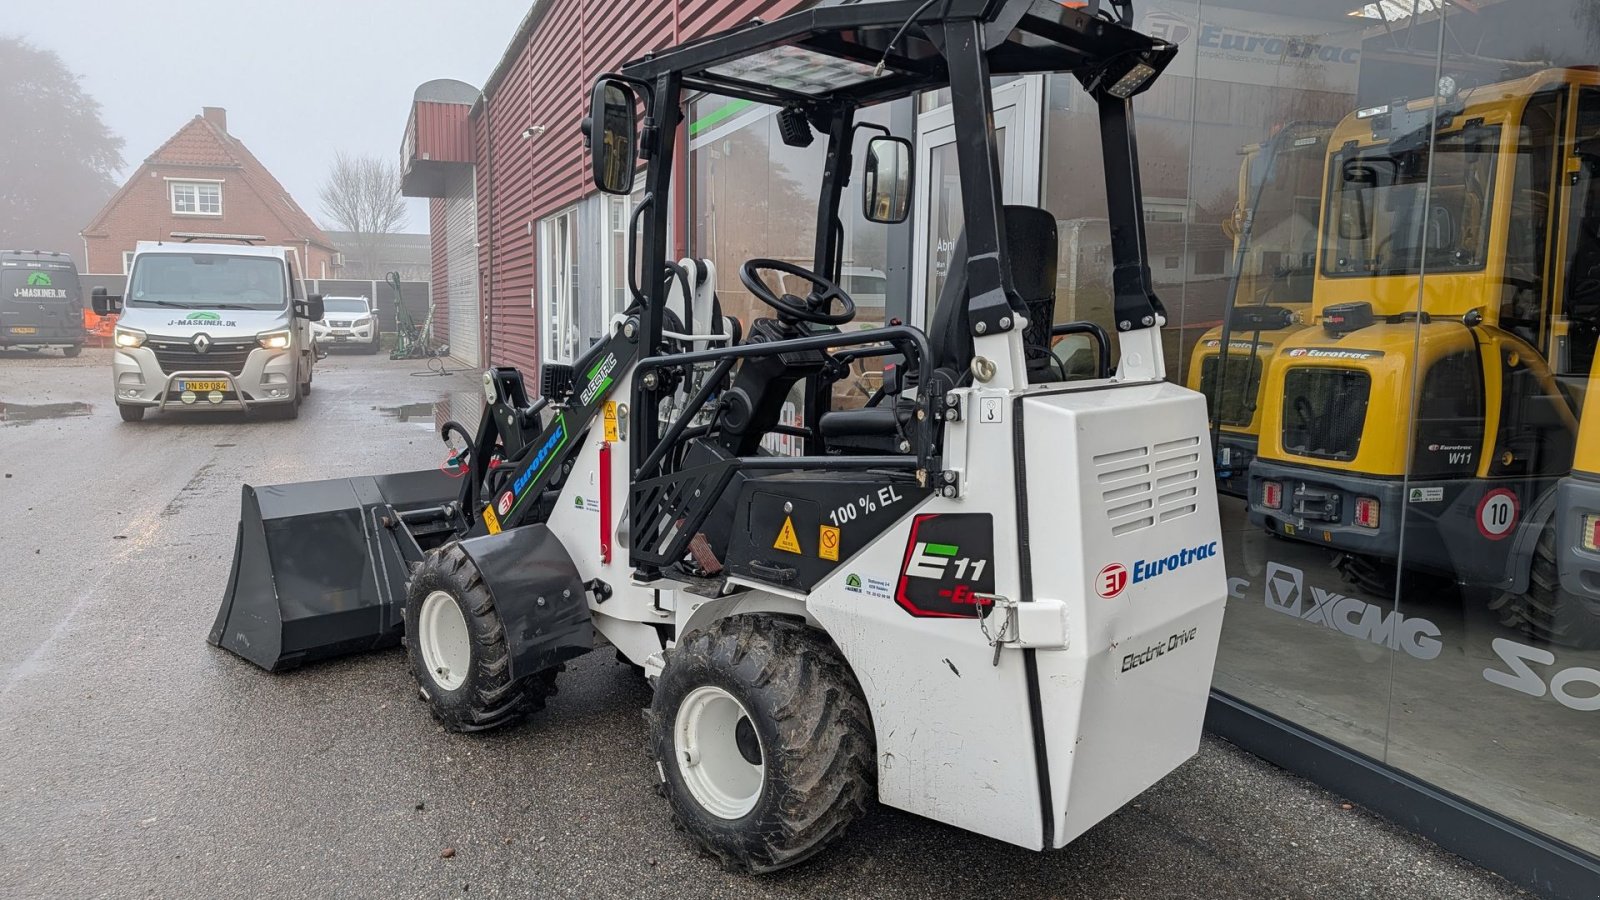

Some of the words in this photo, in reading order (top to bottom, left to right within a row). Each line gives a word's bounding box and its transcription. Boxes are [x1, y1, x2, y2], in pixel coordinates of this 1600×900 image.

[1200, 23, 1361, 64] Eurotrac
[13, 288, 67, 299] J-MASKINER.DK
[167, 319, 237, 328] J-MASKINER.DK
[1308, 349, 1371, 360] Eurotrac
[185, 382, 197, 390] DN
[198, 382, 209, 390] 89
[210, 382, 227, 390] 084
[579, 352, 617, 407] ELECTRIC
[513, 424, 563, 496] Eurotrac
[1448, 452, 1472, 465] W11
[829, 501, 857, 527] 100
[858, 494, 876, 515] %
[877, 485, 903, 507] EL
[1491, 503, 1508, 526] 10
[1132, 540, 1217, 585] Eurotrac
[1301, 585, 1443, 660] XCMG
[1120, 640, 1167, 673] Electric
[1167, 627, 1197, 653] Drive
